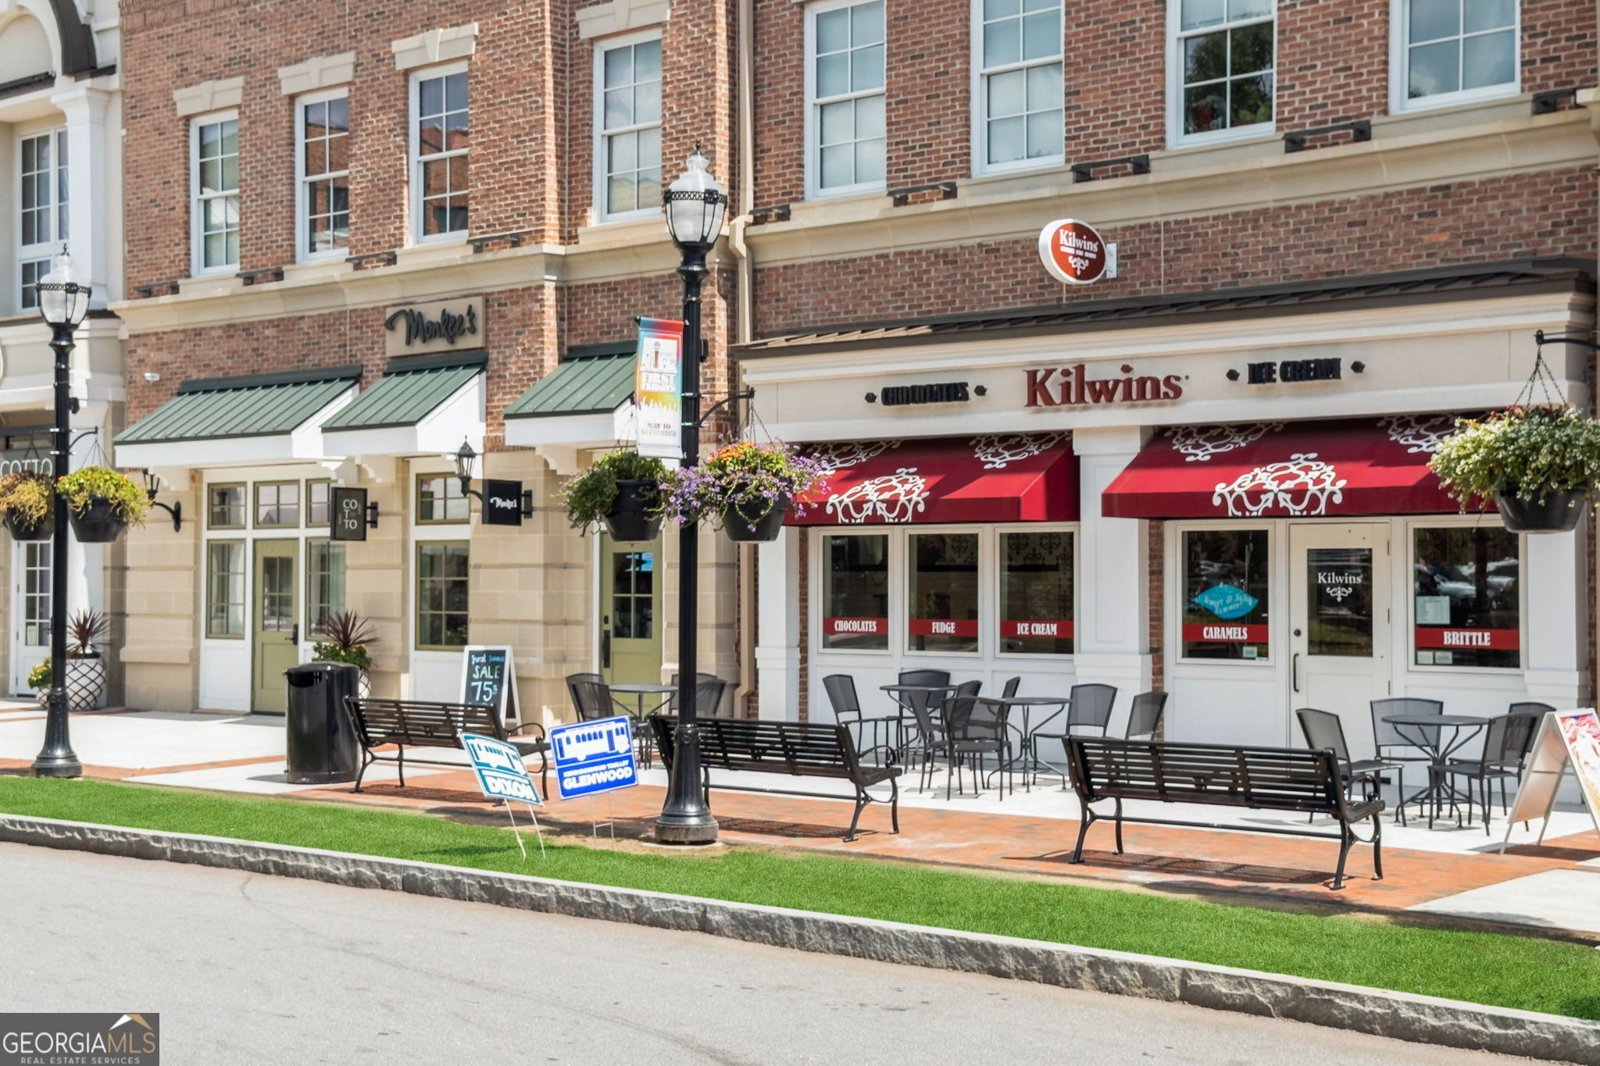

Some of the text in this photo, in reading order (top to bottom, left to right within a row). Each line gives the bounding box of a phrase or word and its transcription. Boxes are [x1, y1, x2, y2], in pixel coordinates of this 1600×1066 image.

[1059, 229, 1099, 253] Kilwins
[1023, 364, 1184, 407] Kilwins
[342, 499, 358, 509] CO
[343, 519, 358, 530] TO
[1317, 571, 1362, 585] Kilwins
[834, 620, 878, 632] CHOCOLATES
[931, 621, 956, 634] FUDGE
[1016, 623, 1058, 635] ICE CREAM
[1203, 626, 1249, 640] CARAMELS
[1443, 631, 1491, 646] BRITTLE
[473, 665, 501, 679] SALE
[563, 766, 633, 790] GLENWOOD
